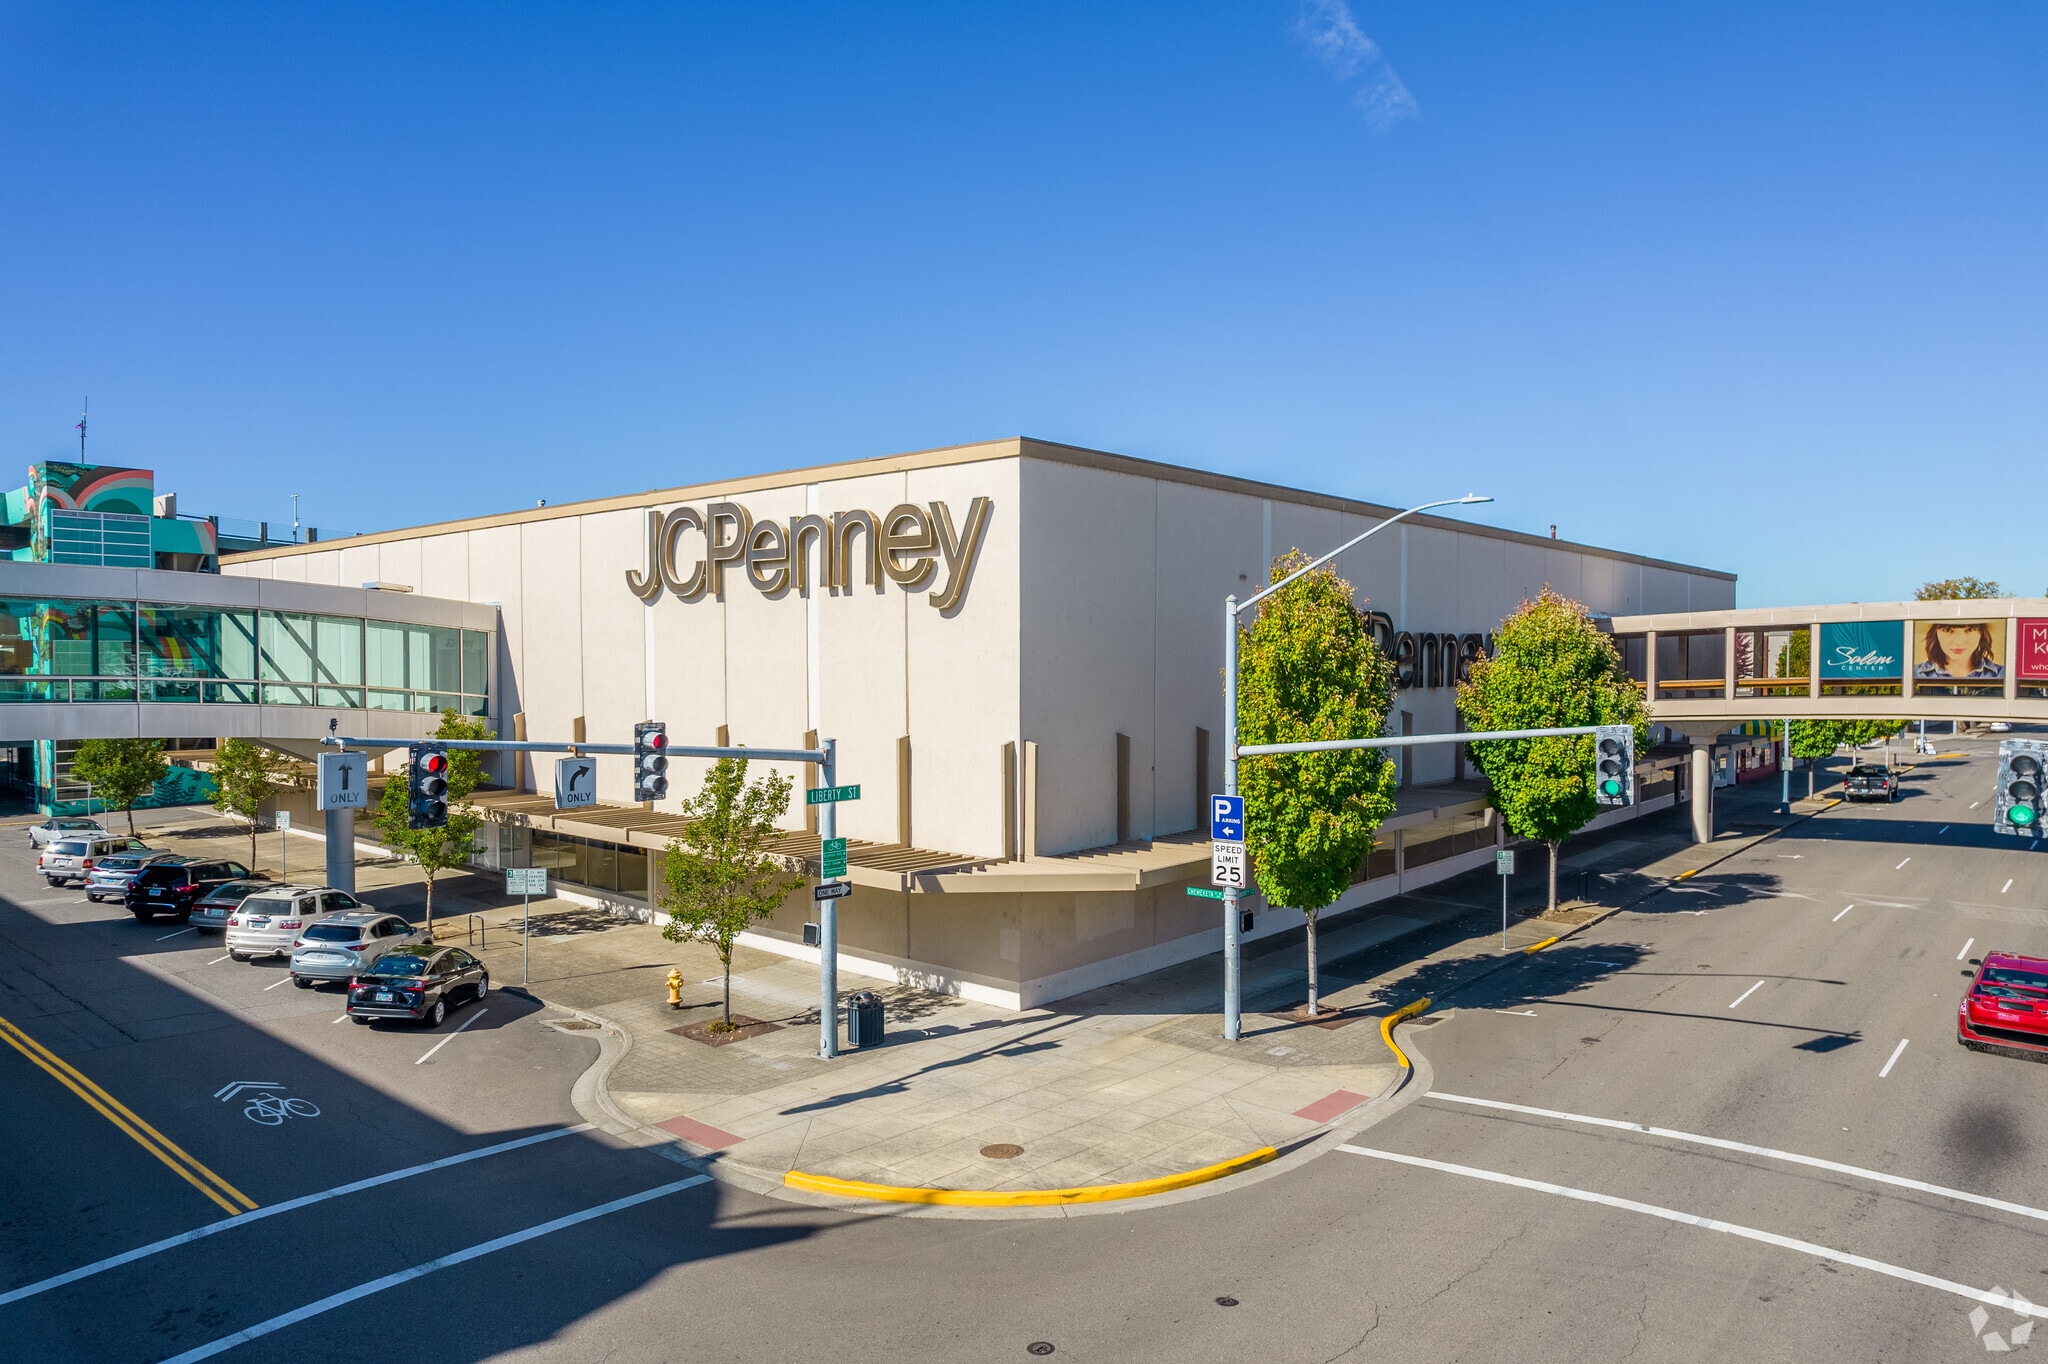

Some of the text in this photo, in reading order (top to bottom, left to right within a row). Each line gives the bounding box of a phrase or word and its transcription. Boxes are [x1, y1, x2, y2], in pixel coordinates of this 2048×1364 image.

[625, 496, 991, 611] JCPenney
[1827, 646, 1896, 666] Salem
[330, 792, 360, 804] ONLY
[567, 791, 592, 803] ONLY
[811, 786, 857, 803] LIBERTY ST
[1214, 844, 1243, 855] SPEED
[1217, 855, 1239, 864] LIMIT
[1215, 865, 1241, 883] 25
[818, 887, 842, 897] ONE WAY
